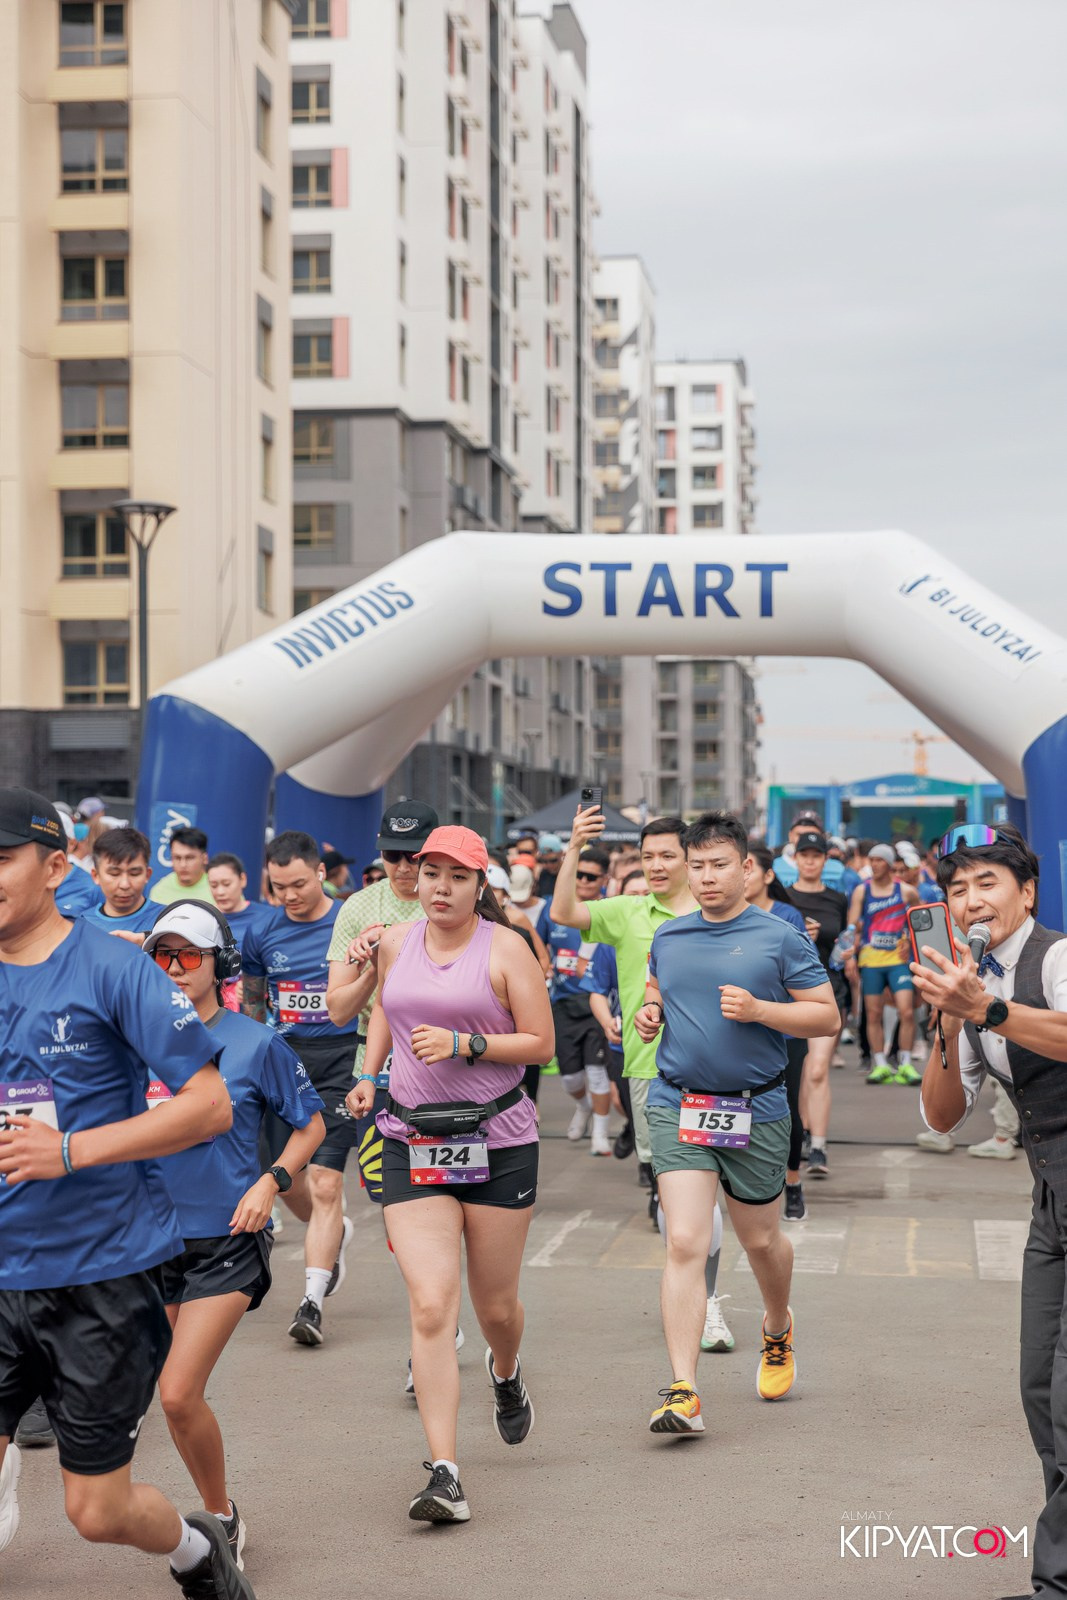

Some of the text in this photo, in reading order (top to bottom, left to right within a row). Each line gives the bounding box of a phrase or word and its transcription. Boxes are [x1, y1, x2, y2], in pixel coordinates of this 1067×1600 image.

[541, 561, 789, 618] START
[929, 588, 957, 608] BI
[273, 581, 415, 669] INVICTUS
[288, 995, 321, 1009] 508
[16, 1087, 37, 1096] GROUP
[698, 1112, 737, 1131] 153
[428, 1147, 470, 1165] 124
